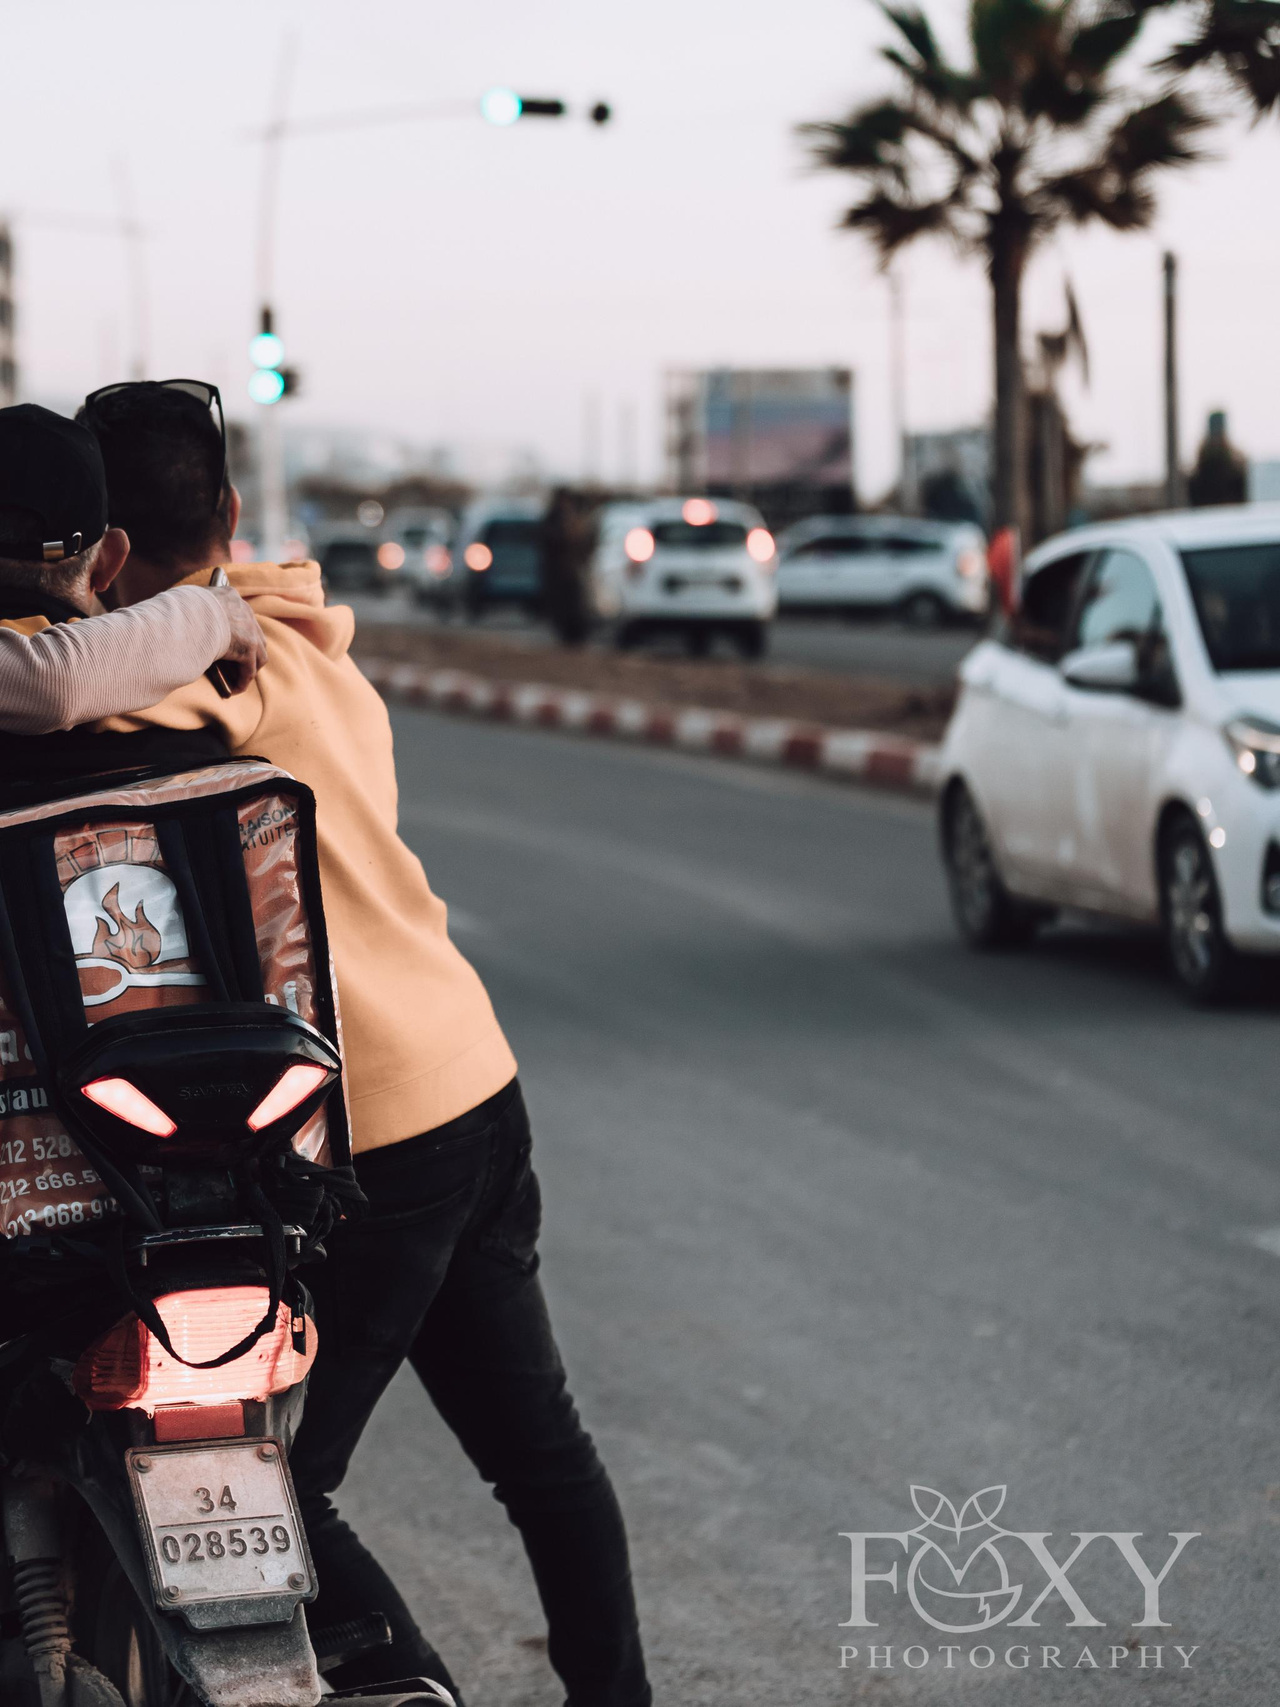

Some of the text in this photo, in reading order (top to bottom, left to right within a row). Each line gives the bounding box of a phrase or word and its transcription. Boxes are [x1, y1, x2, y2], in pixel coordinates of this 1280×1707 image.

[32, 1134, 83, 1161] 528.
[35, 1169, 102, 1191] 666.5
[194, 1485, 237, 1513] 34
[162, 1525, 291, 1563] 028539
